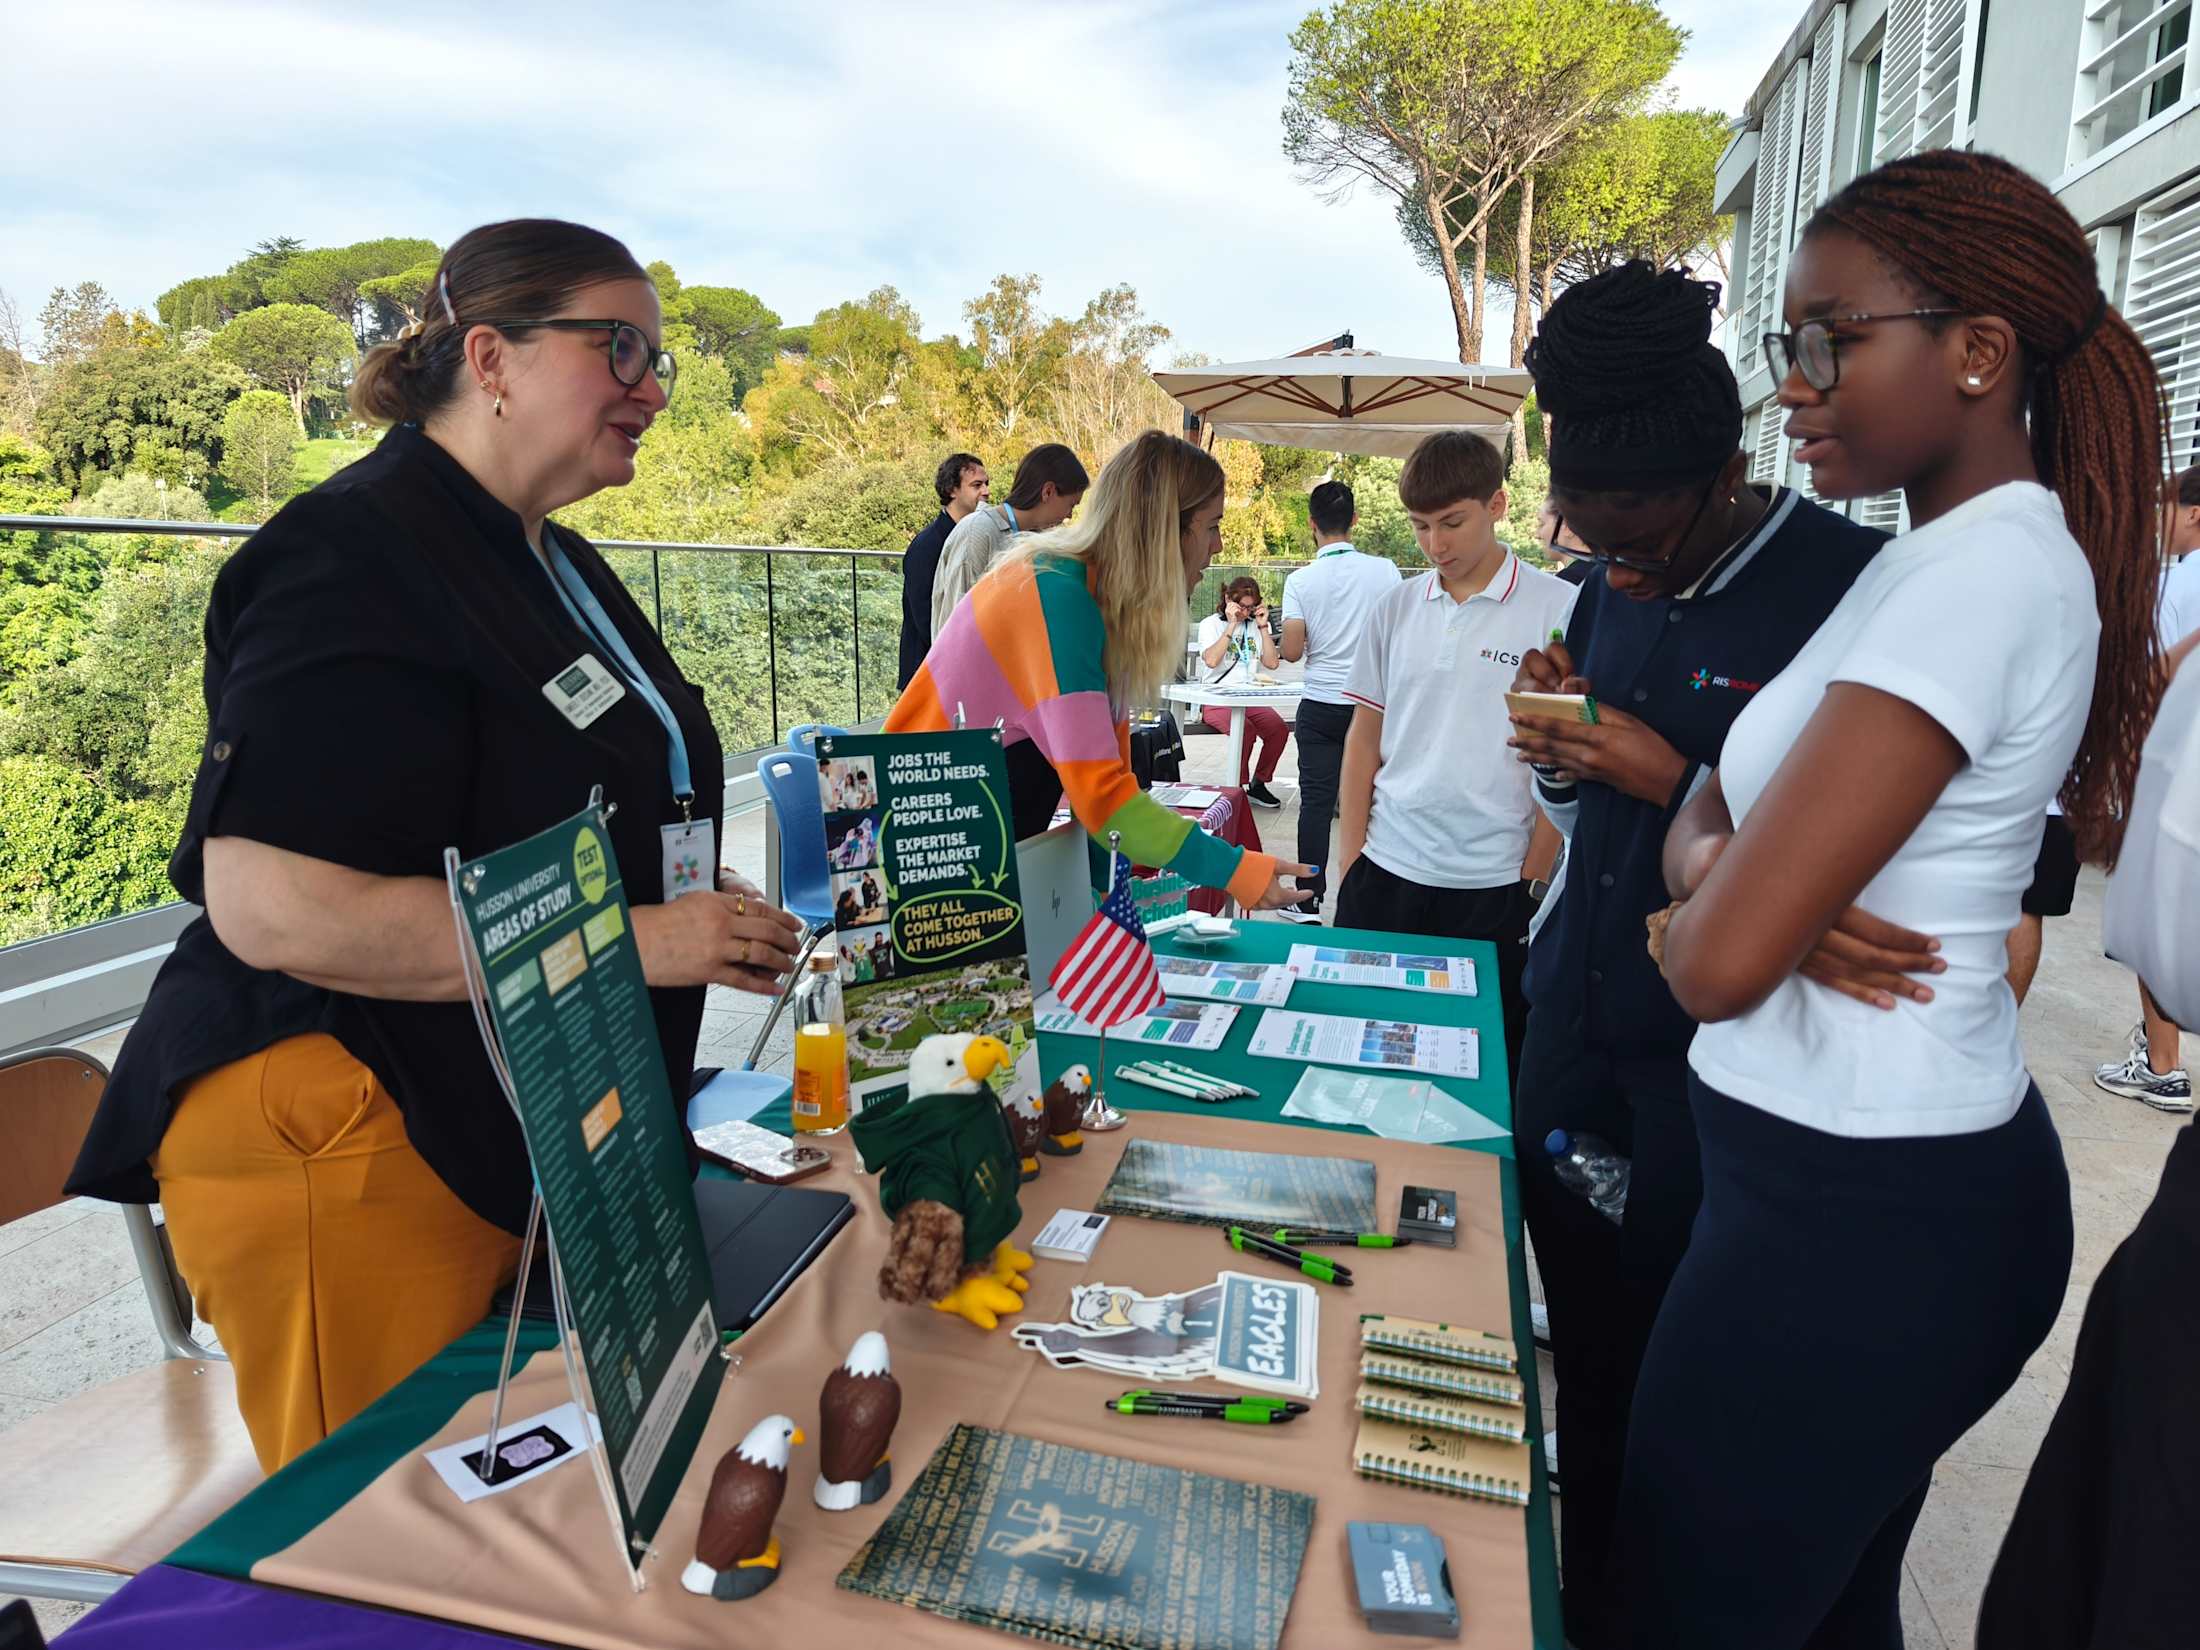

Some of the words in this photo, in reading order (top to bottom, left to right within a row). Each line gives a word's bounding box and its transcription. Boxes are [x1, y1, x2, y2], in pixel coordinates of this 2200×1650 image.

[888, 754, 922, 769] JOBS
[925, 752, 951, 766] THE
[888, 768, 941, 784] WORLD
[943, 764, 990, 780] NEEDS.
[891, 793, 952, 810] CAREERS
[893, 809, 944, 826] PEOPLE
[946, 805, 983, 821] LOVE.
[577, 844, 598, 866] TEST
[896, 832, 967, 852] EXPERTISE
[897, 853, 925, 868] THE
[927, 846, 981, 864] MARKET
[899, 863, 968, 884] DEMANDS.
[475, 888, 514, 922] HUSSON
[513, 862, 560, 900] UNIVERSITY
[1051, 888, 1061, 918] hp
[483, 914, 521, 957] AREAS
[520, 903, 537, 931] OF
[537, 881, 572, 920] STUDY
[902, 902, 938, 920] THEY
[940, 900, 965, 915] ALL
[904, 920, 943, 938] COME
[944, 907, 1014, 929] TOGETHER
[906, 937, 924, 953] AT
[925, 928, 984, 949] HUSSON.
[1246, 1281, 1288, 1378] EAGLES
[951, 1425, 970, 1455] PART
[979, 1436, 997, 1465] HOW
[945, 1453, 960, 1469] BE
[1019, 1460, 1038, 1490] HOW
[934, 1473, 953, 1499] CAN
[1096, 1475, 1115, 1505] HOW
[1211, 1479, 1227, 1504] CAN
[900, 1492, 928, 1543] EXPLORE
[924, 1497, 943, 1528] HOW
[1207, 1503, 1225, 1534] HOW
[1240, 1499, 1258, 1528] HOW
[1090, 1518, 1126, 1575] HUSSON
[1391, 1550, 1418, 1605] SOMEDAY
